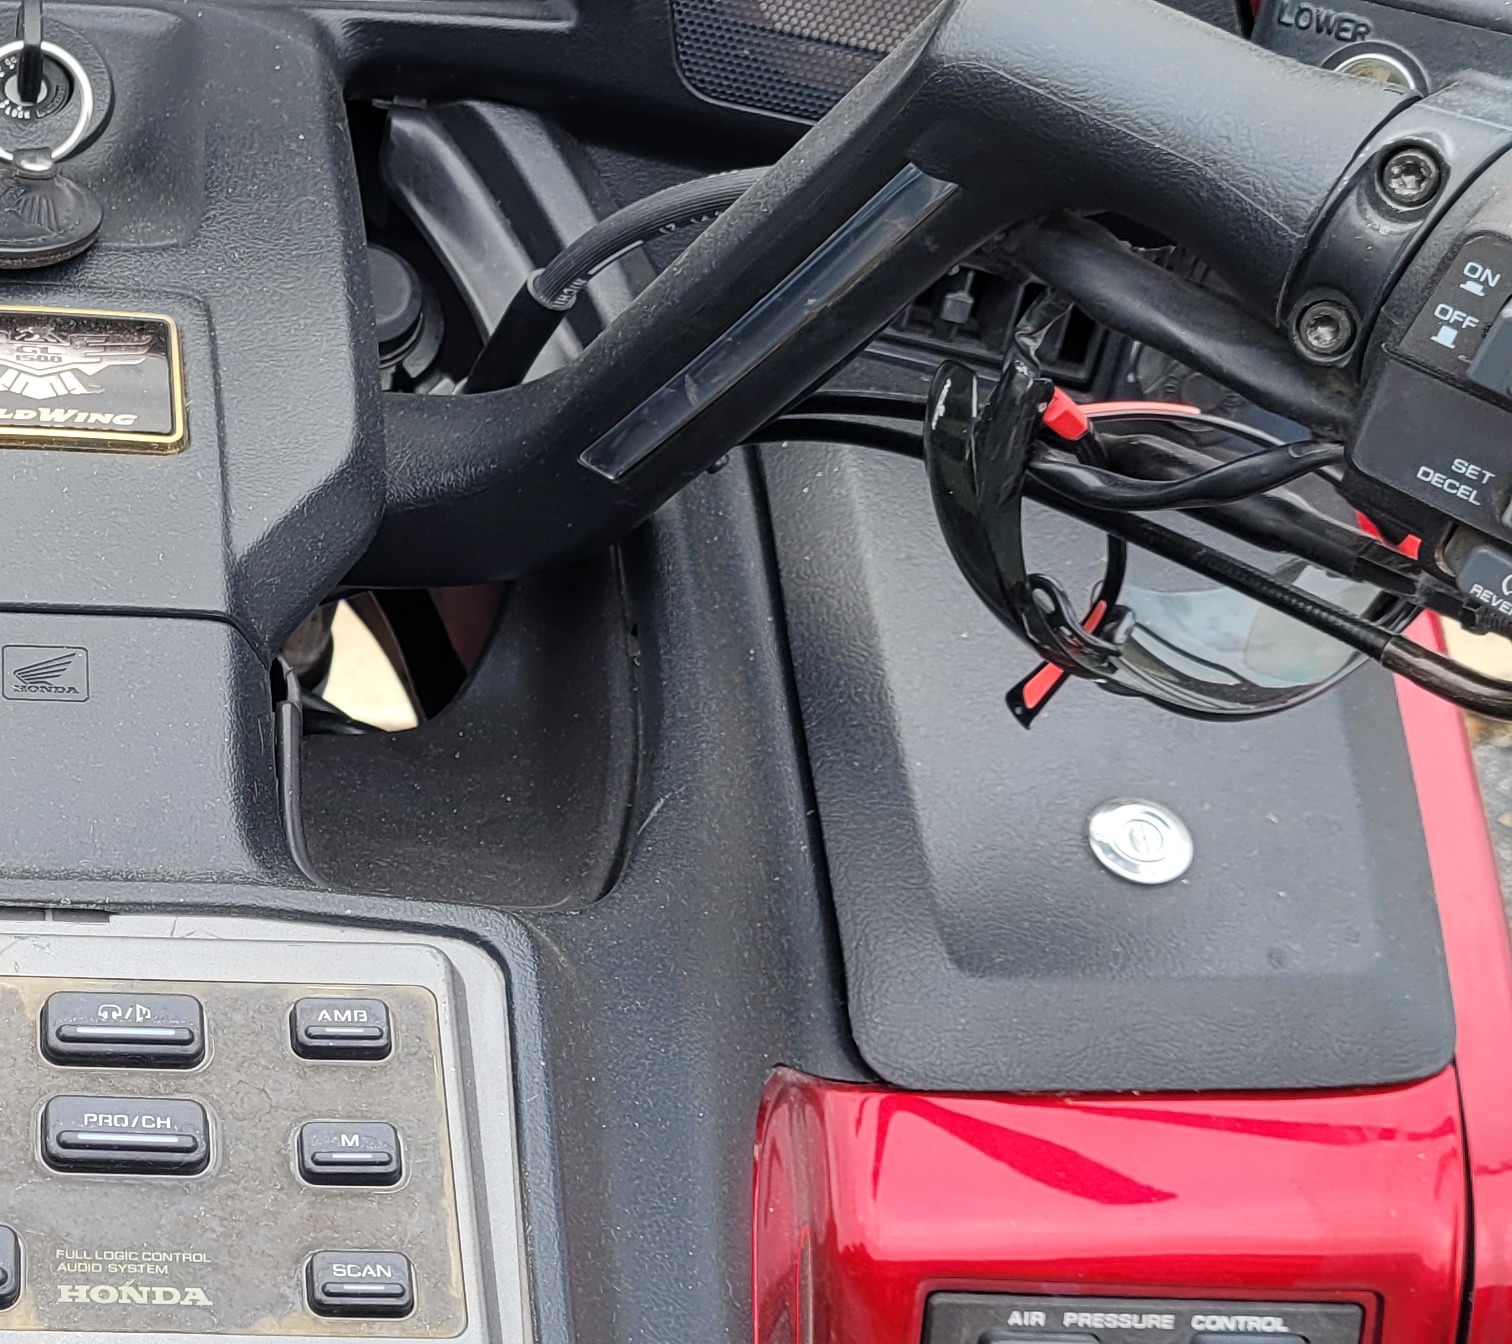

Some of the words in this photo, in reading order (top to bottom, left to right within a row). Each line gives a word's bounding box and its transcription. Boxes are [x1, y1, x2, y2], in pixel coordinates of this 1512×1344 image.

[1463, 260, 1502, 289] ON
[1433, 303, 1481, 330] OFF
[1450, 457, 1496, 486] SET
[1416, 465, 1482, 507] DECEL
[12, 685, 80, 695] HONDA
[316, 1008, 368, 1023] AMB
[340, 1133, 361, 1147] M
[55, 1249, 93, 1260] FULL
[94, 1250, 139, 1261] LOGIC
[141, 1251, 212, 1263] CONTROL
[57, 1263, 103, 1273] AUDIO
[107, 1263, 170, 1275] SYSTEM
[331, 1262, 393, 1278] SCAN
[56, 1284, 214, 1306] HONDA
[1007, 1310, 1047, 1327] AIR
[1062, 1311, 1176, 1331] PRESSURE
[1190, 1314, 1289, 1333] CONTROL
